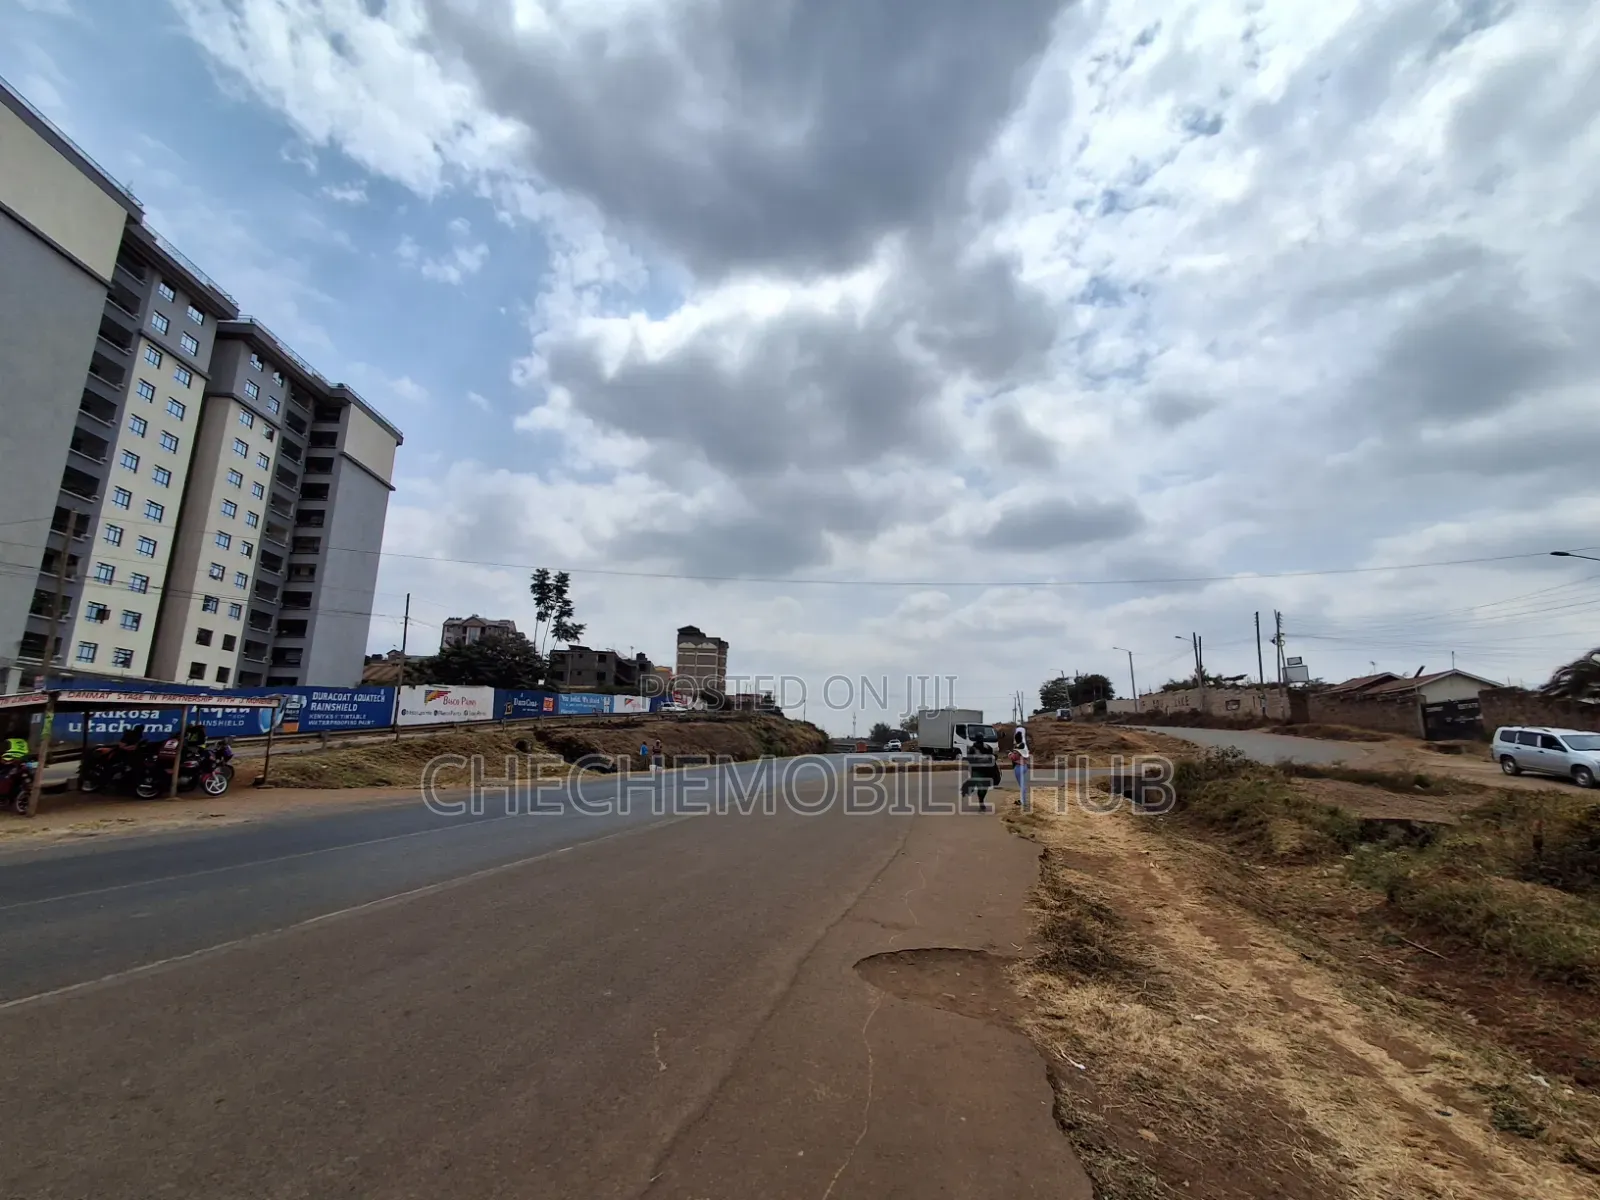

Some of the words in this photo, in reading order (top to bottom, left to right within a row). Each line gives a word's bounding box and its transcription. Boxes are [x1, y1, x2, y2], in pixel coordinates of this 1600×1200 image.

[312, 692, 351, 701] DURACOAT
[353, 694, 385, 702] AQUATECH
[310, 703, 358, 711] RAINSHIELD
